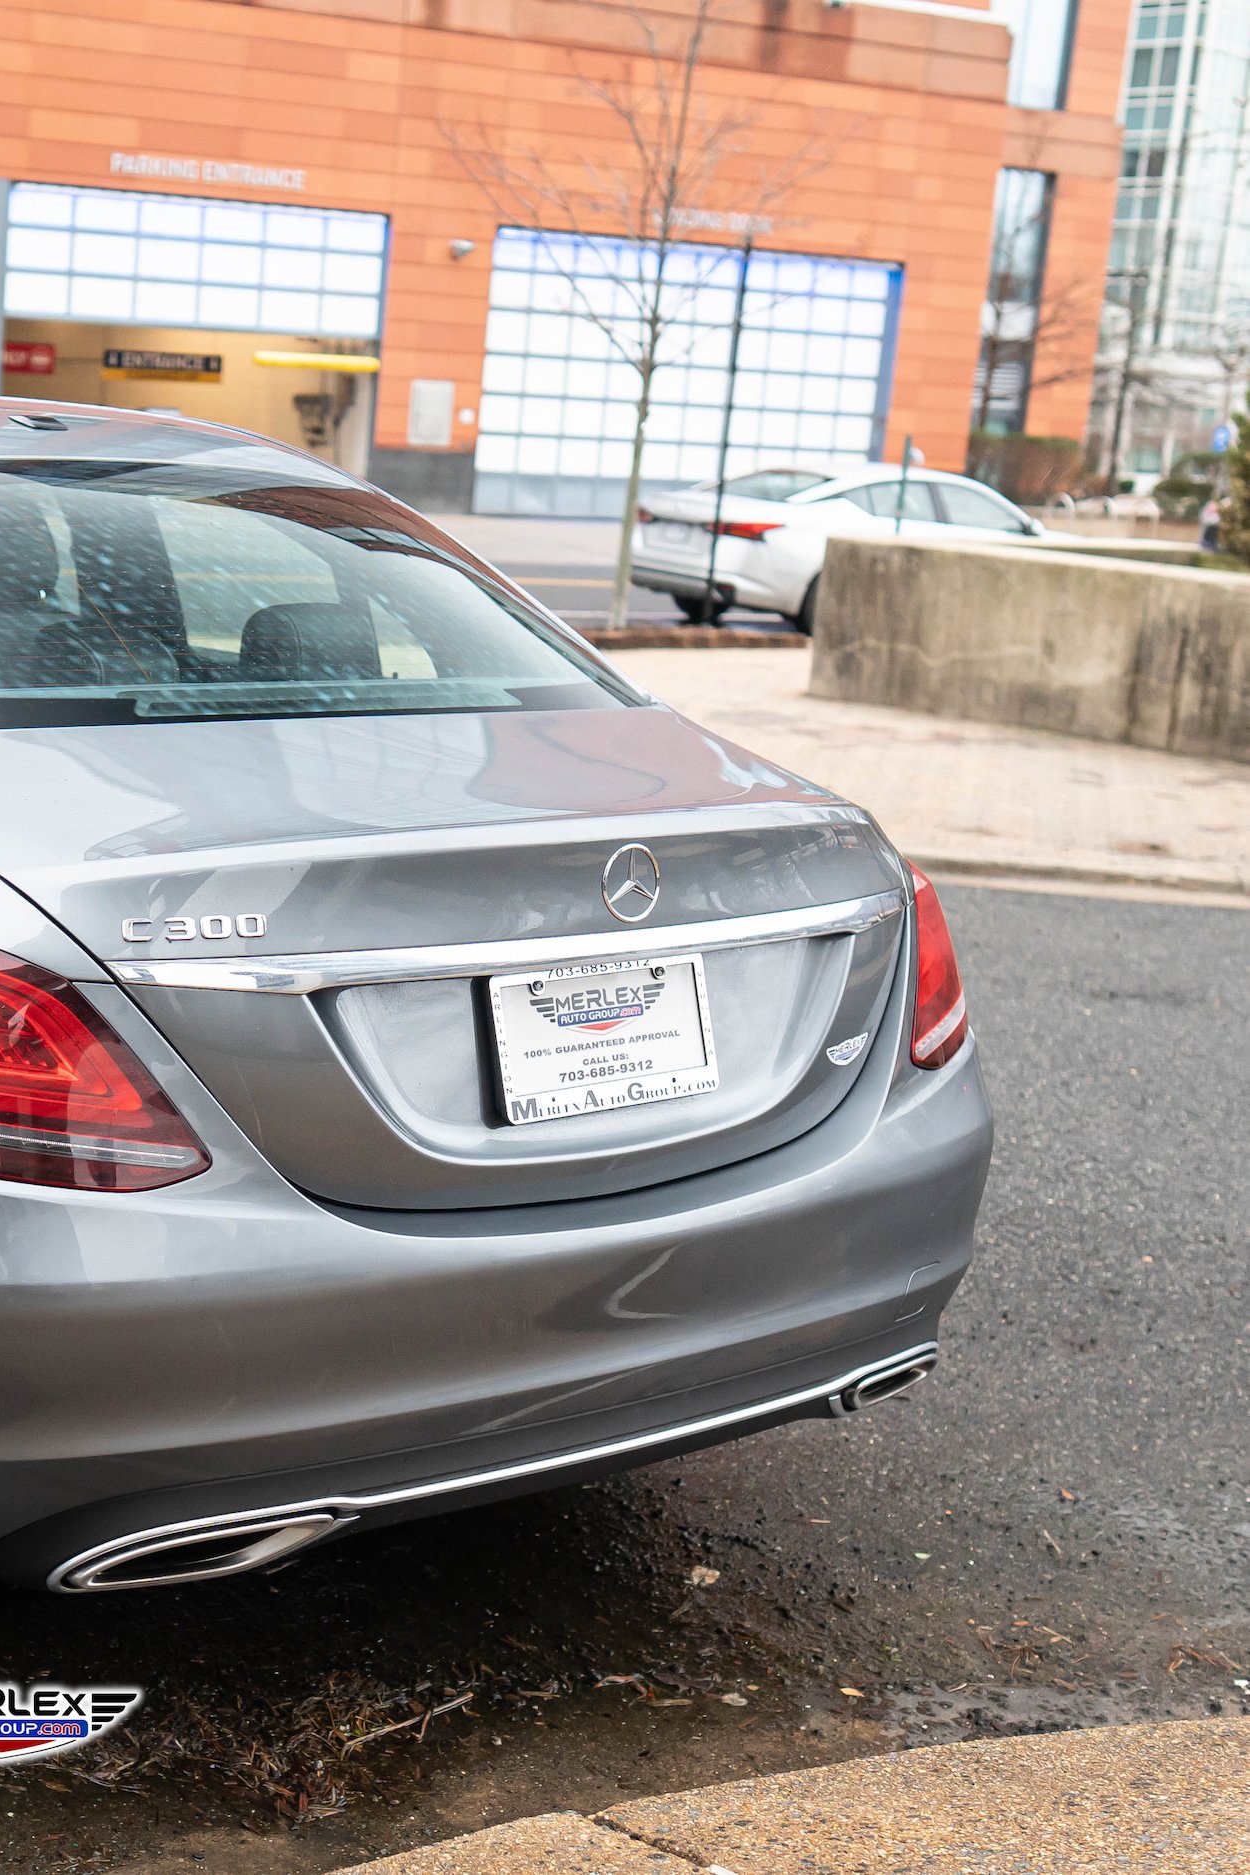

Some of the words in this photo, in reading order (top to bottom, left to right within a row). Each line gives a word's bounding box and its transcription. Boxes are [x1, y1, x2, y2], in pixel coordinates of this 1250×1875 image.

[110, 152, 198, 180] PARKING
[201, 160, 307, 190] ENTRANCE
[121, 917, 153, 942] C
[164, 914, 267, 943] 300
[555, 986, 643, 1013] MERLEX
[560, 1010, 587, 1025] AUTO
[524, 1047, 552, 1060] 100%
[555, 1036, 626, 1055] GUARANTEED
[628, 1030, 681, 1044] APPROVAL
[559, 1059, 654, 1083] 703-685-9312
[582, 1053, 609, 1067] CALL
[612, 1052, 630, 1062] US:
